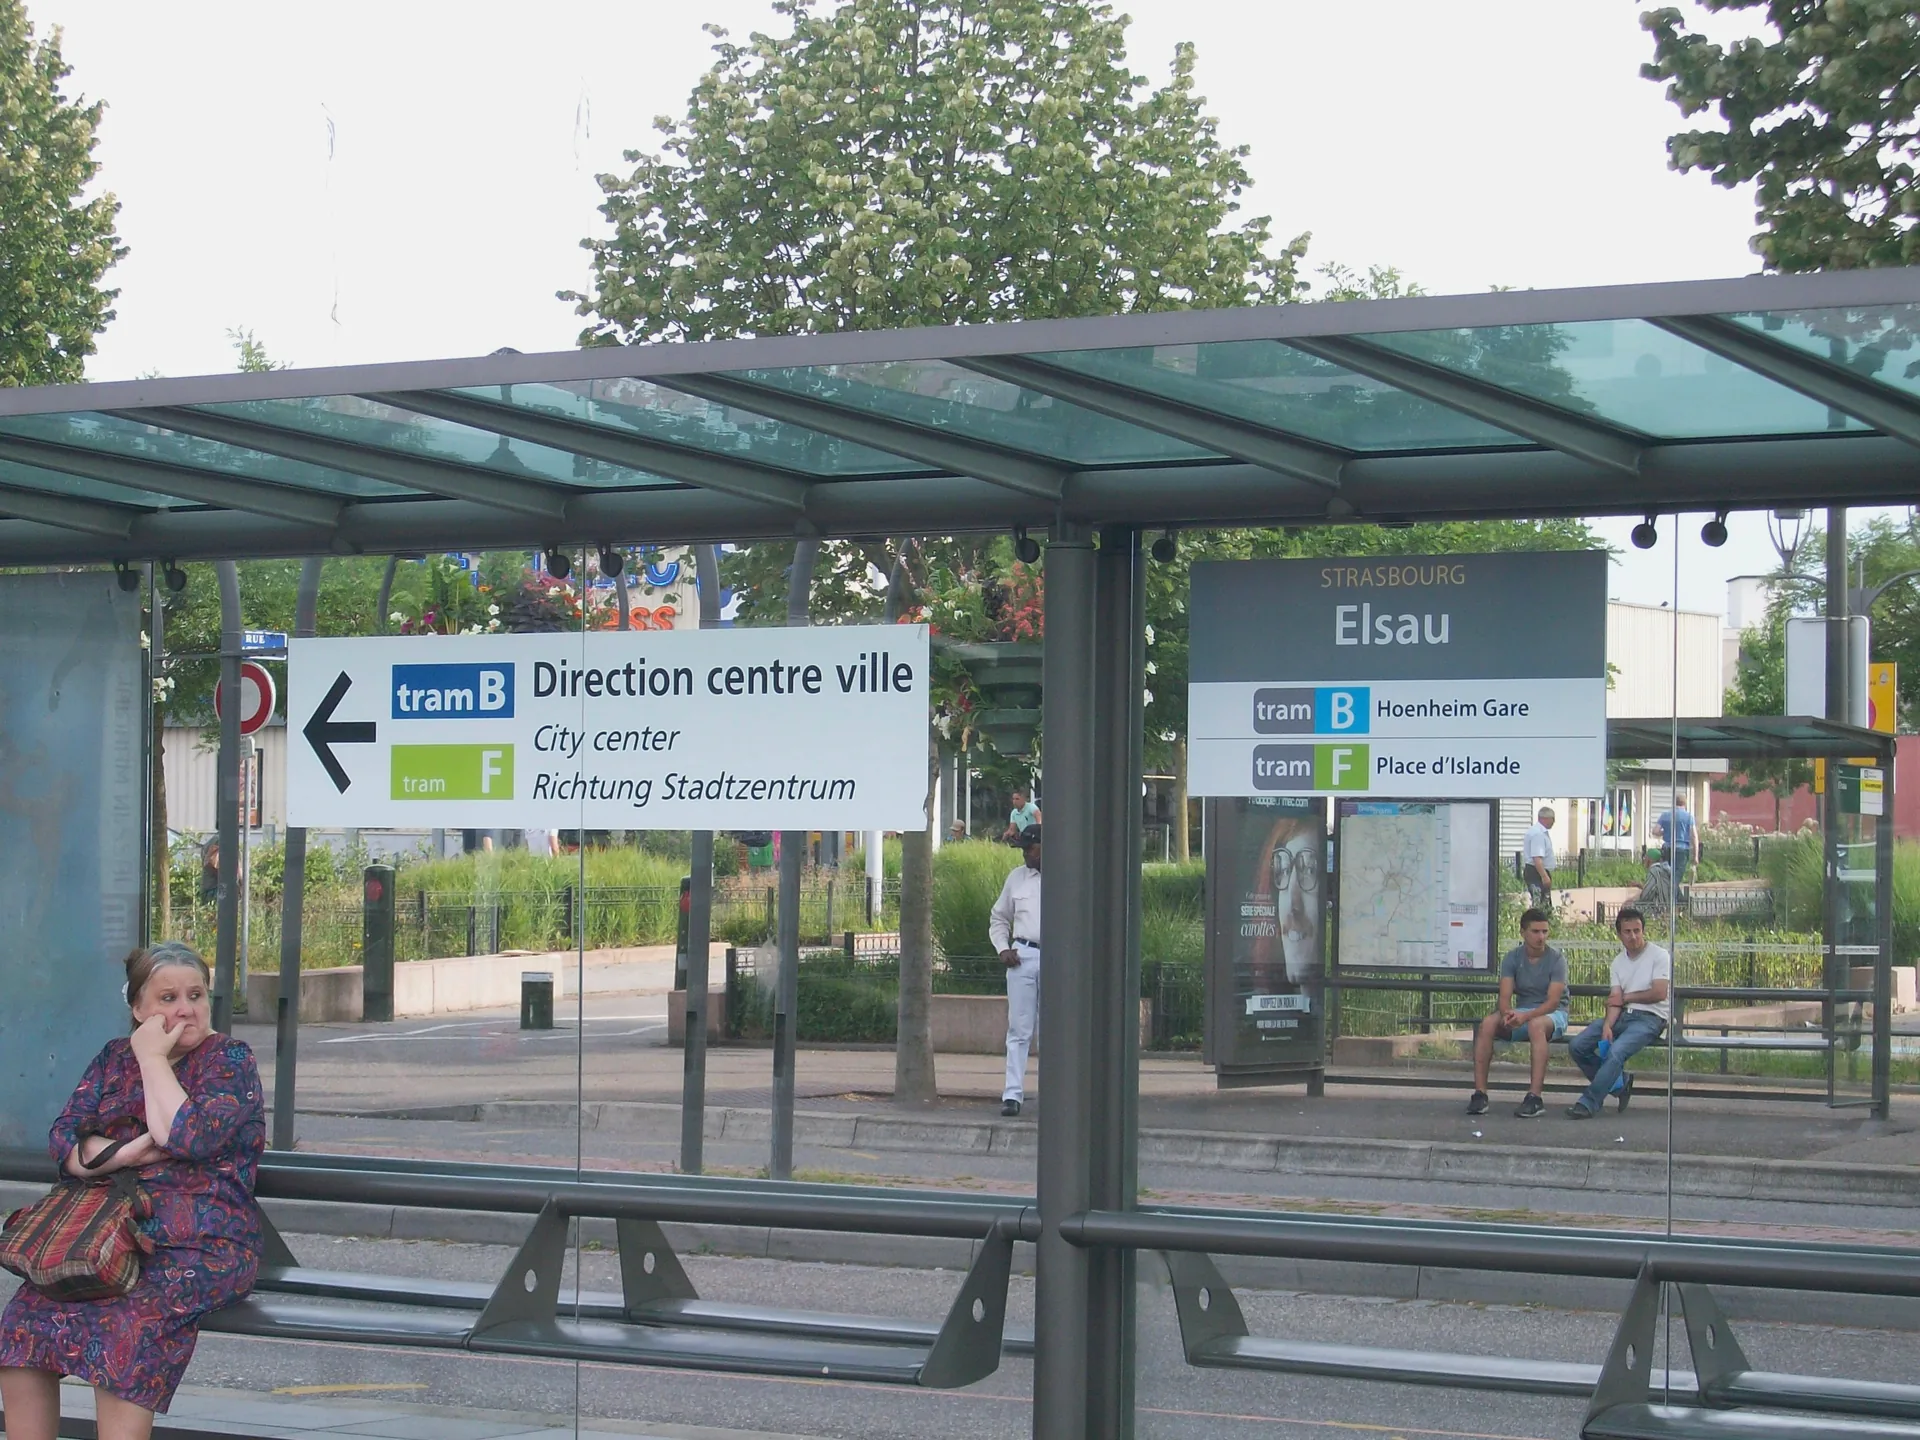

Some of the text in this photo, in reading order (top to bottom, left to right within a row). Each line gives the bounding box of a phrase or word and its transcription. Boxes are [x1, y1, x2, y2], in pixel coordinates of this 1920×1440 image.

[1321, 565, 1465, 588] STRASBOURG
[245, 634, 265, 644] RUE
[1335, 603, 1450, 645] Elsau
[533, 652, 913, 697] Direction centre ville
[1257, 692, 1355, 729] tram B
[1378, 699, 1530, 717] Hoenheim Gare
[534, 724, 681, 759] City center
[403, 750, 502, 794] tram F
[1256, 749, 1353, 785] tram F
[1377, 756, 1521, 775] Place d'Islande
[532, 771, 856, 808] Richtung Stadtzentrum
[1240, 921, 1276, 937] carottes
